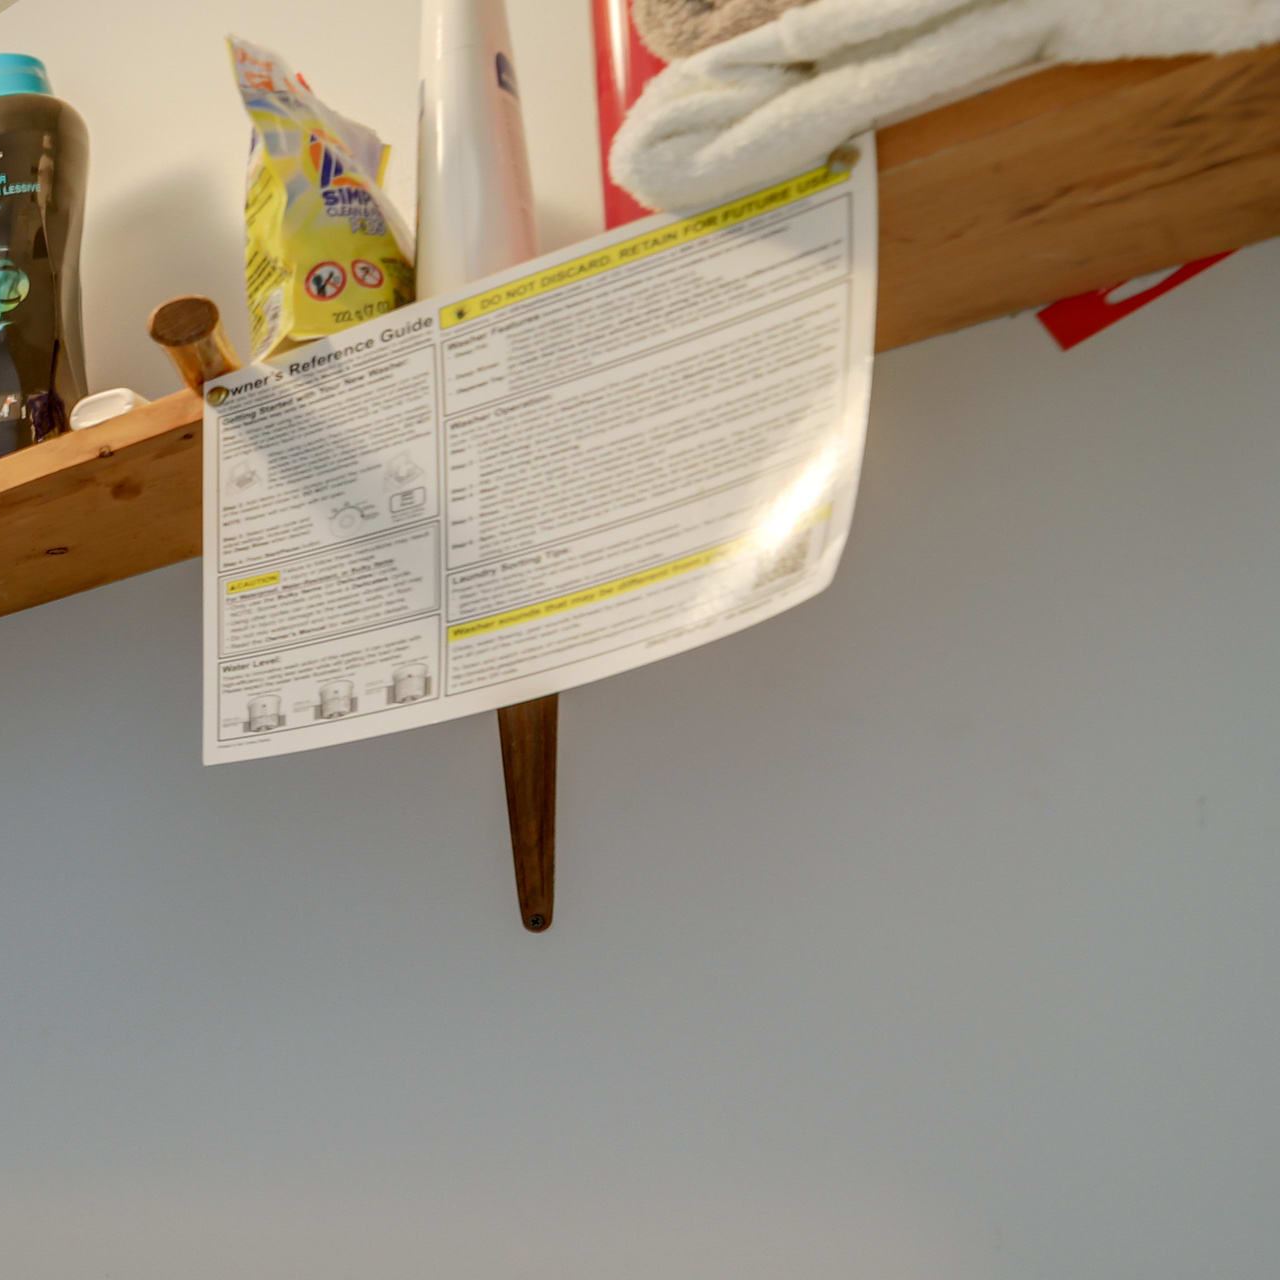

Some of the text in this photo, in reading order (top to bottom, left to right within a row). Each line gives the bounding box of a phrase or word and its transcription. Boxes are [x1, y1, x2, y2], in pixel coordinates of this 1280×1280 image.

[479, 294, 502, 311] DO
[505, 281, 537, 301] NOT
[618, 231, 679, 261] RETAIN
[682, 216, 718, 238] FOR
[721, 189, 792, 223] FUTURE
[796, 171, 833, 196] USE
[229, 315, 434, 397] wner's Reference Guide
[237, 573, 278, 589] CAUTION
